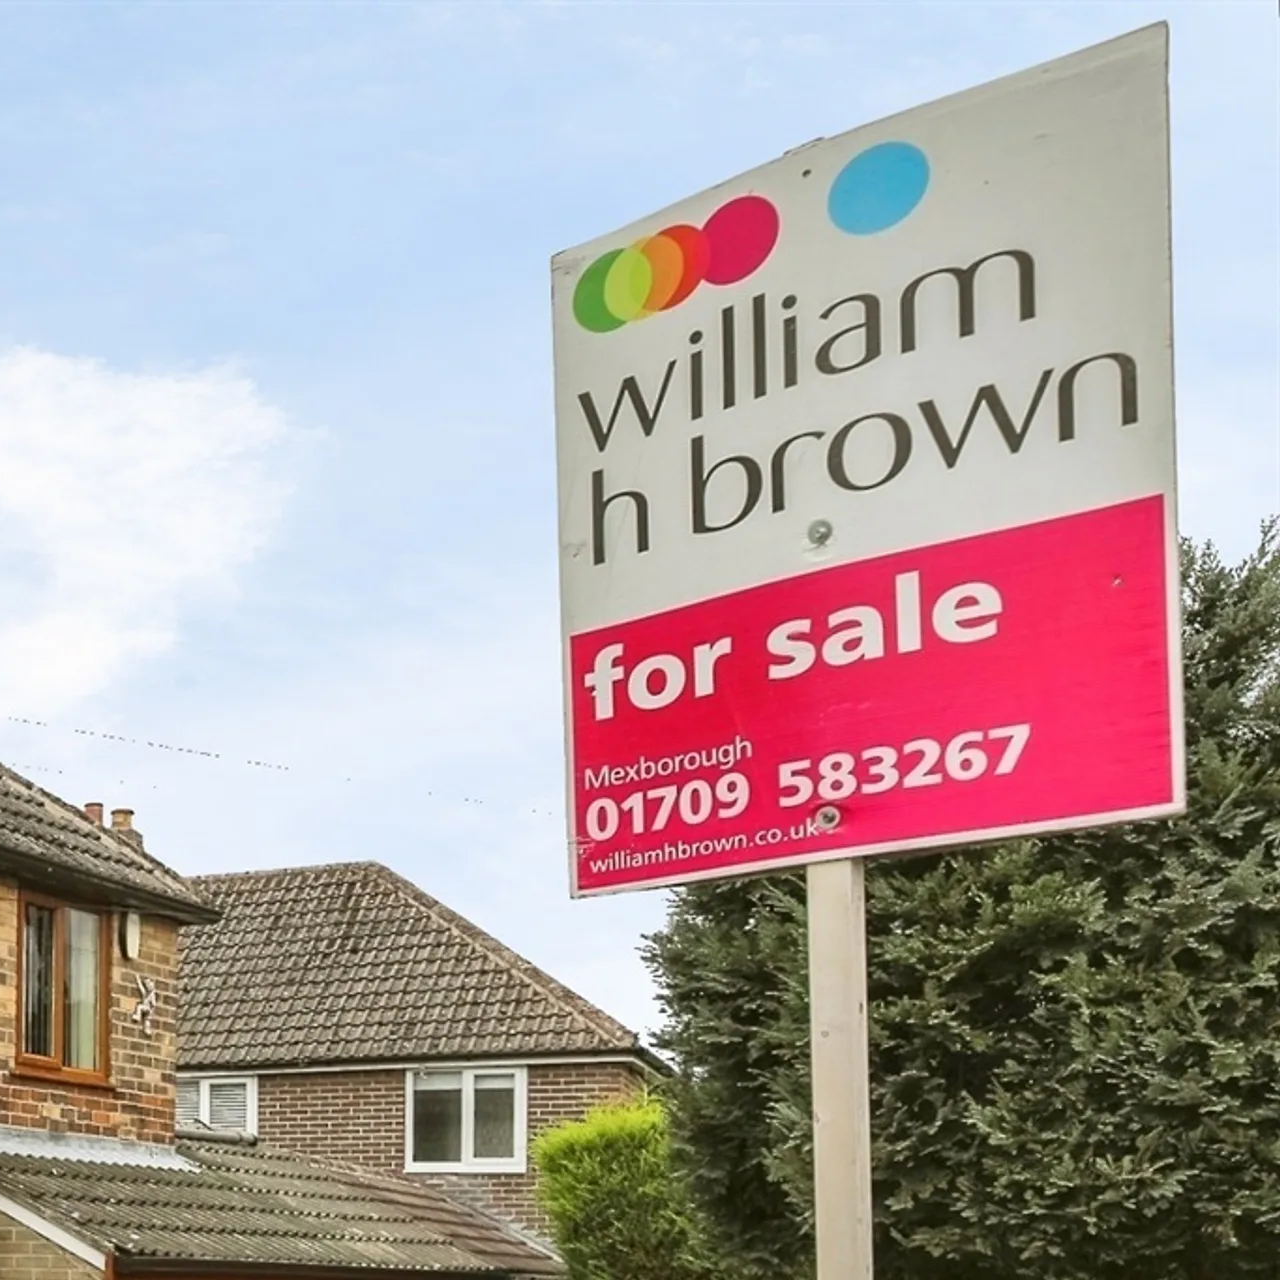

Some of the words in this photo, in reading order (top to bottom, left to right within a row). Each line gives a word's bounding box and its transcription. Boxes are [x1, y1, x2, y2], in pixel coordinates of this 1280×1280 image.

[577, 248, 1035, 451] william
[592, 468, 650, 565] h
[691, 352, 1139, 534] brown
[584, 637, 732, 721] for
[766, 571, 1003, 680] sale
[585, 737, 752, 788] Mexborough
[586, 773, 750, 841] 01709
[778, 724, 1031, 807] 583267
[590, 817, 820, 873] williamhbrown.co.uk
